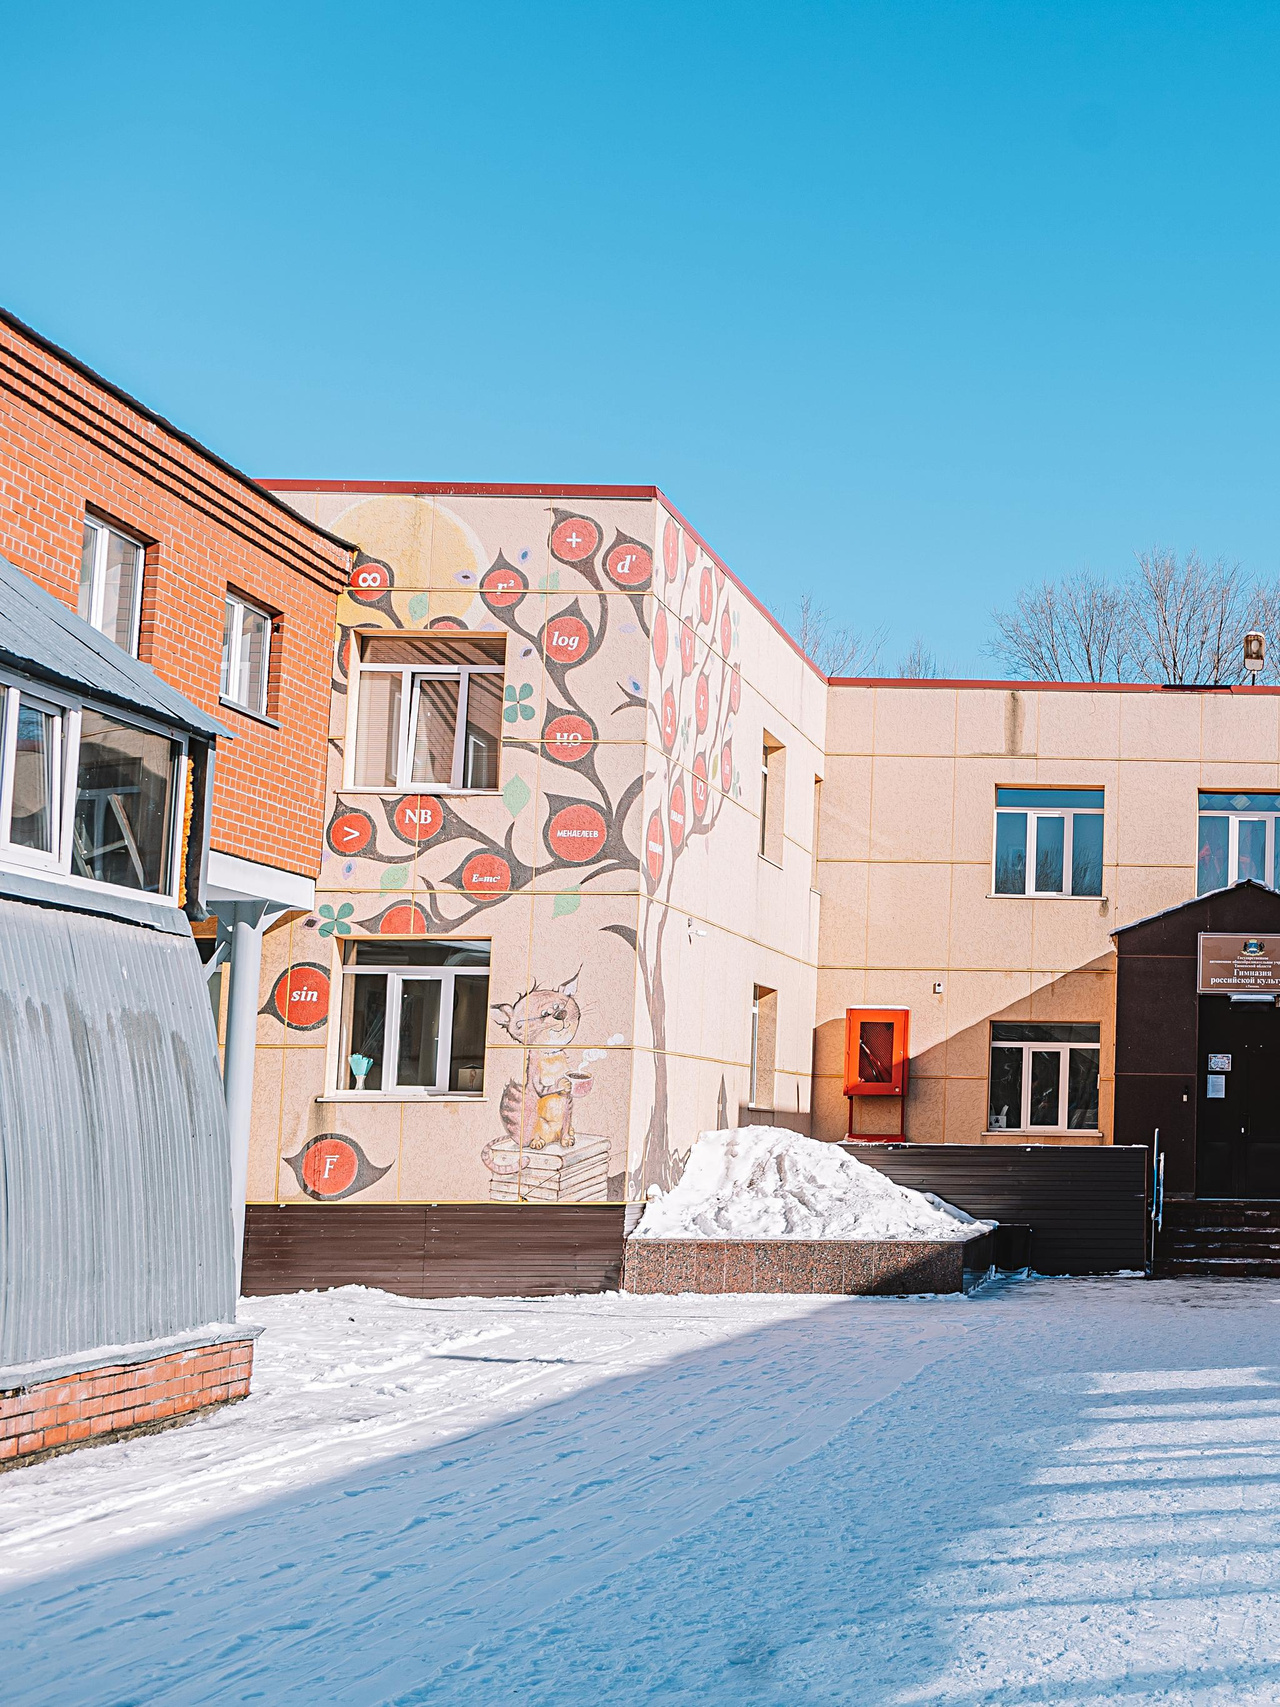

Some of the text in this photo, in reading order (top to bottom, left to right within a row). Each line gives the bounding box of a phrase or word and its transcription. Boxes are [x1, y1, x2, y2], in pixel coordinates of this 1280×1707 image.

[552, 631, 580, 650] log
[404, 808, 432, 824] NB
[556, 829, 599, 838] МЕНДЕЛЕЕВ
[1234, 969, 1272, 977] Гимназия
[1210, 977, 1255, 985] российской
[291, 986, 318, 1002] sin
